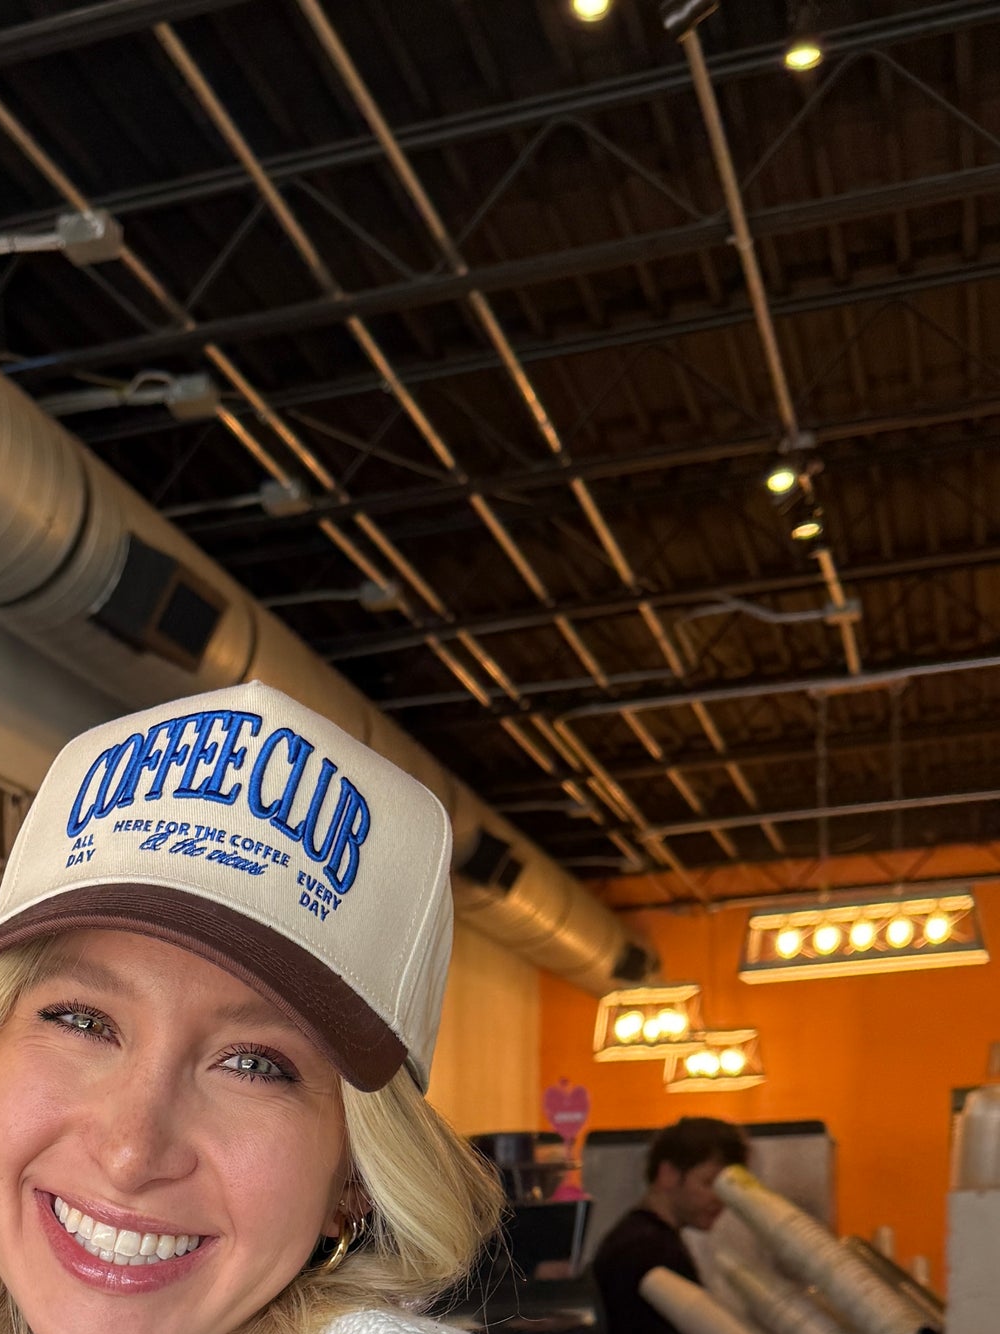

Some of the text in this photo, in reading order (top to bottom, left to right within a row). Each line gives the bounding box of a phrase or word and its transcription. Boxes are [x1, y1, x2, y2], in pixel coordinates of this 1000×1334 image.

[66, 709, 371, 895] COFFEE CLUB
[65, 848, 96, 868] DAY
[71, 834, 94, 851] ALL
[113, 820, 290, 868] HERE FOR THE COFFEE
[296, 870, 342, 911] EVERY
[299, 891, 330, 922] DAY
